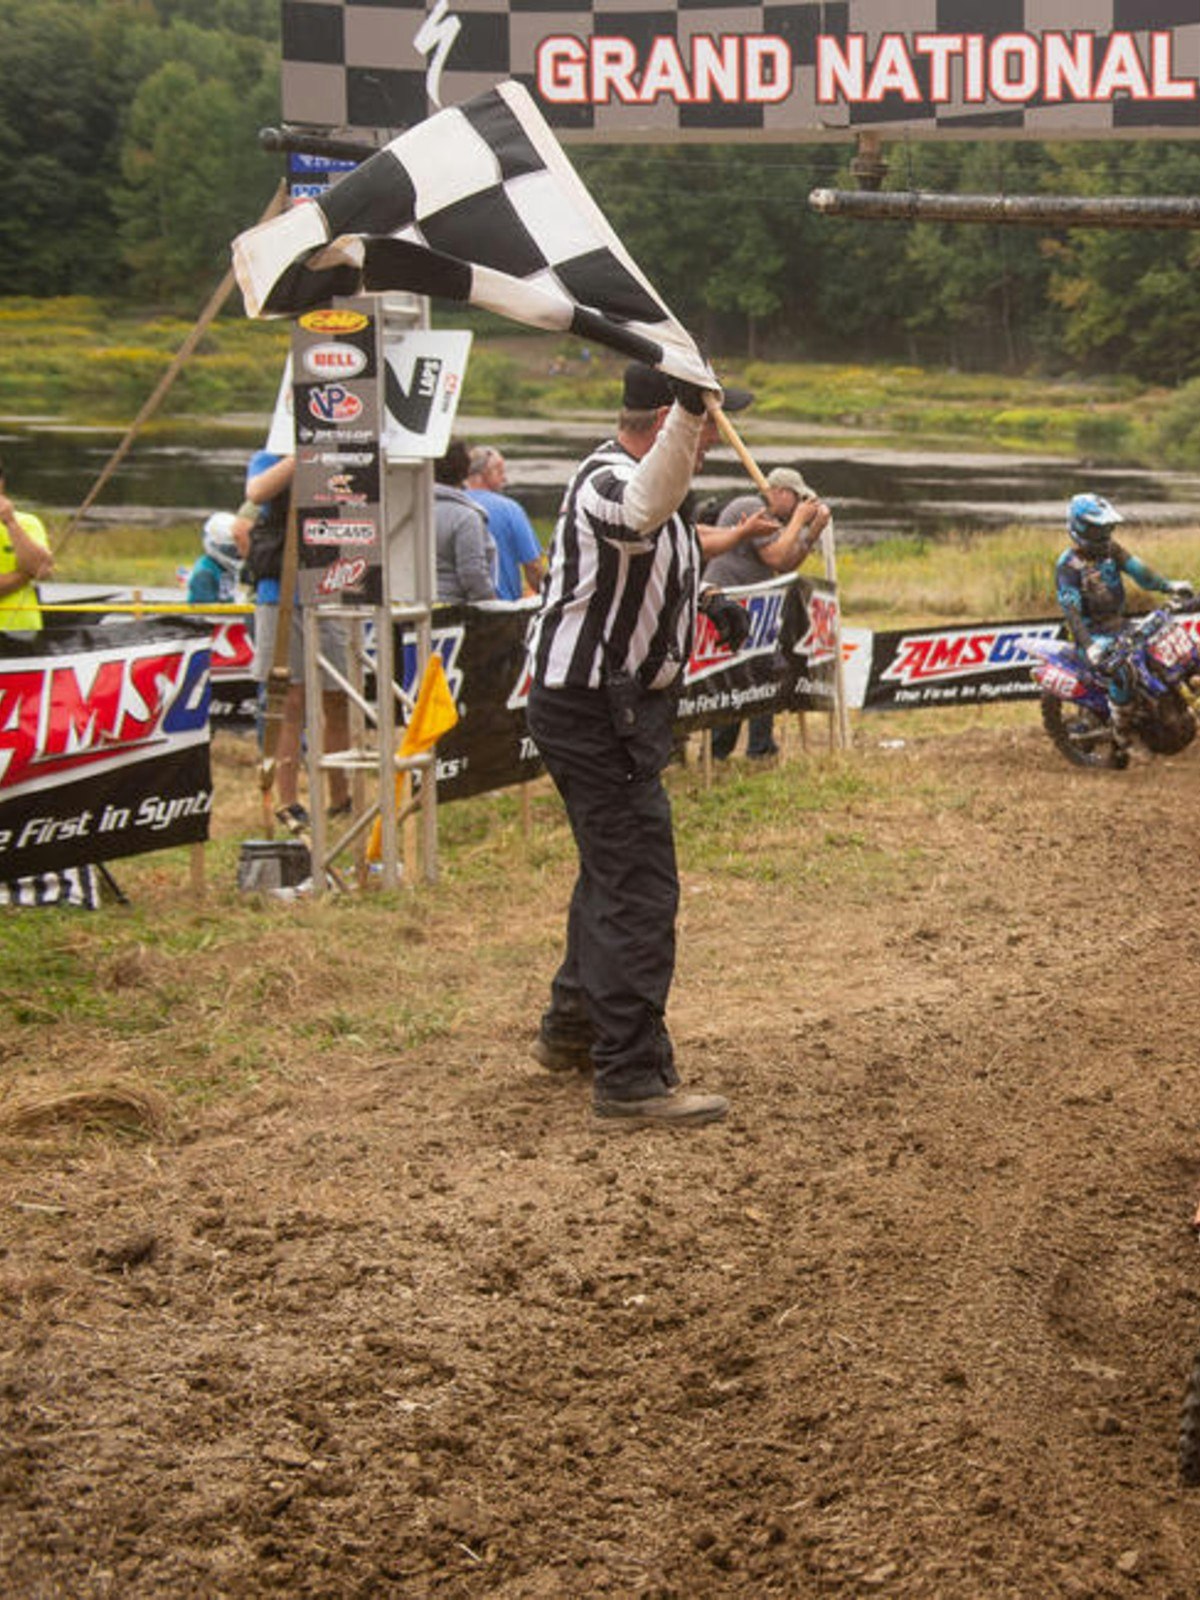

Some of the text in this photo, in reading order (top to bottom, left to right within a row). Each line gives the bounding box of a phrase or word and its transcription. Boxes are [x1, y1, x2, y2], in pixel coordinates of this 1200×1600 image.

[536, 33, 792, 103] GRAND
[816, 31, 1198, 103] NATIONAL
[313, 353, 356, 367] BELL
[418, 360, 441, 397] LAPS
[313, 387, 346, 419] VP
[886, 628, 1056, 683] AMSO
[696, 693, 718, 713] First
[720, 691, 730, 708] in
[730, 682, 778, 710] Synthetics
[894, 688, 921, 702] The
[922, 685, 959, 700] First
[960, 685, 976, 698] in
[16, 811, 94, 849] First
[98, 804, 131, 833] in
